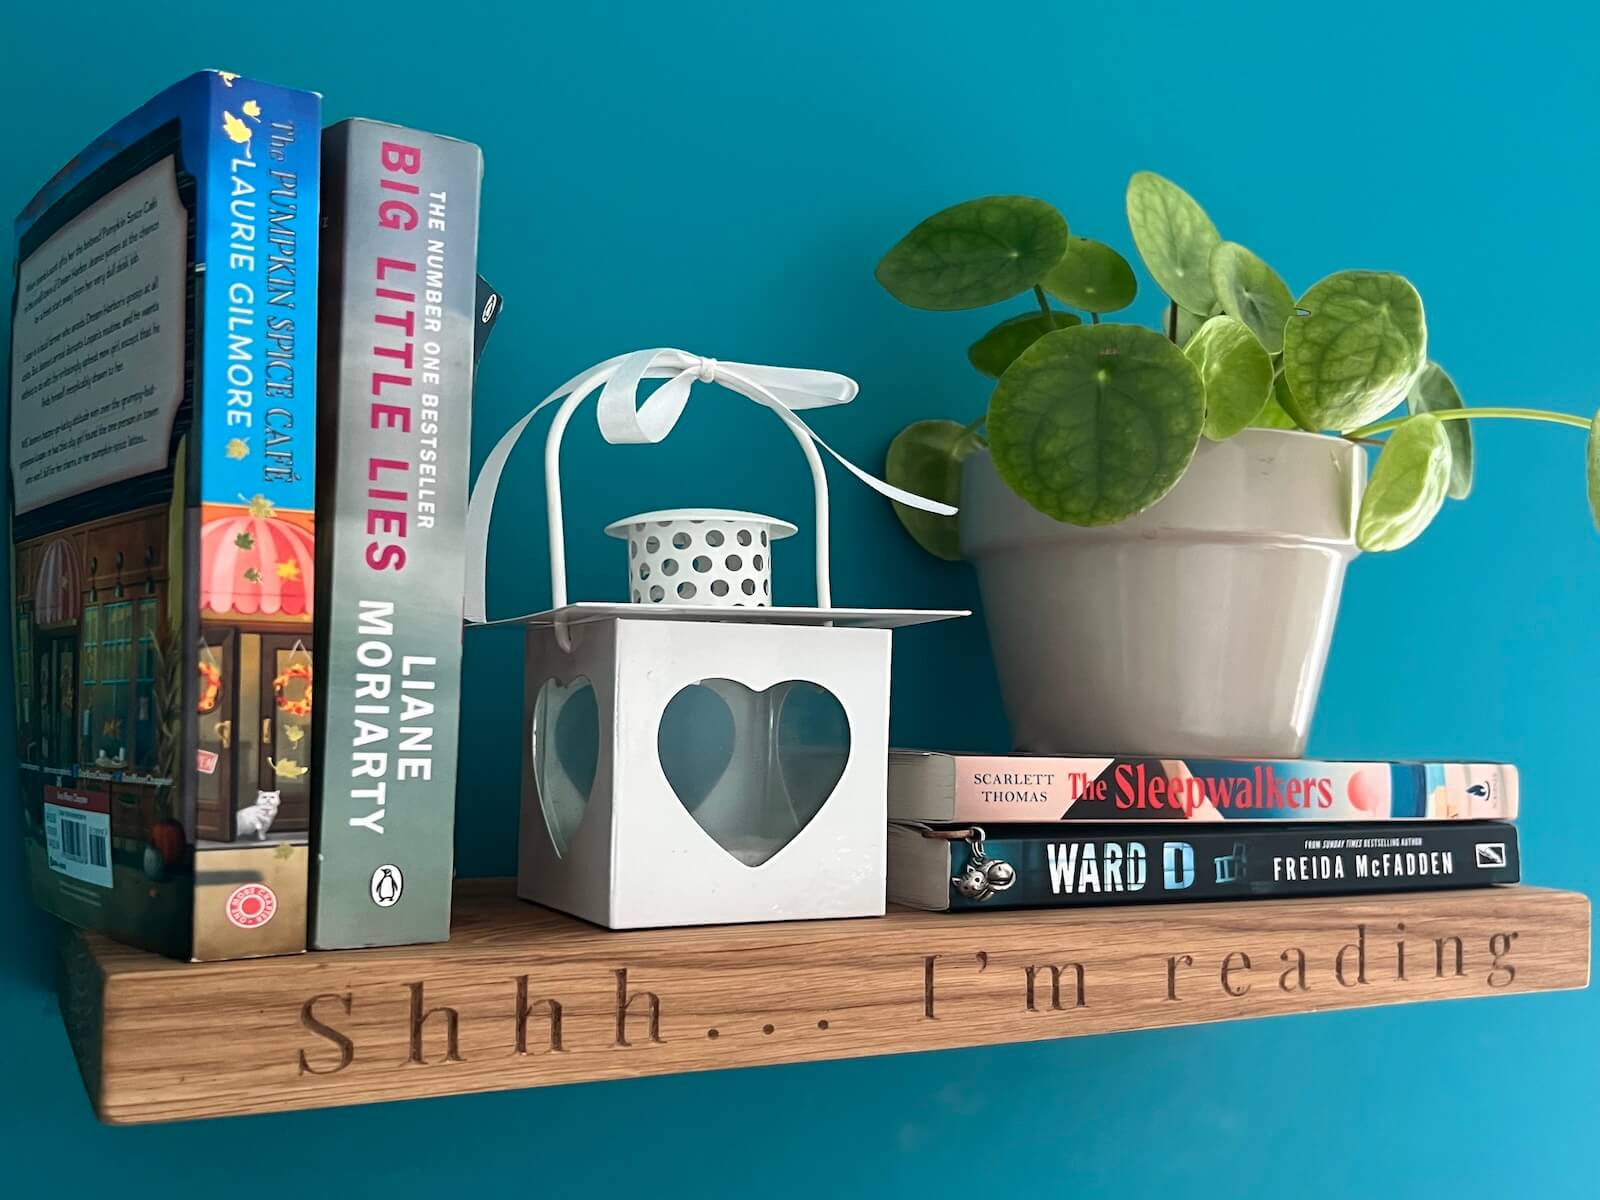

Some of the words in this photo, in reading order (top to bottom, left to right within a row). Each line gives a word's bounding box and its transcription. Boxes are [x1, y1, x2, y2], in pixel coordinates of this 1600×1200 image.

[269, 119, 295, 163] The
[229, 158, 256, 272] LAURIE
[377, 141, 421, 232] BIG
[427, 192, 447, 232] THE
[267, 167, 298, 310] PUMPKIN
[424, 240, 445, 333] NUMBER
[226, 283, 255, 428] GILMORE
[264, 313, 297, 399] SPICE
[370, 256, 417, 434] LITTLE
[422, 342, 441, 385] ONE
[264, 407, 302, 484] CAFÉ
[417, 394, 439, 529] BESTSELLER
[365, 457, 410, 571] LIES
[349, 600, 395, 834] MORIARTY
[397, 655, 437, 781] LIANE
[973, 773, 1055, 785] SCARLETT
[981, 791, 1048, 803] THOMAS
[1068, 772, 1107, 801] The
[1114, 763, 1333, 819] Sleepwalkers
[1047, 841, 1147, 894] WARD
[1162, 841, 1195, 890] D
[1273, 853, 1345, 882] FREIDA
[1356, 851, 1453, 879] McFADDEN
[1161, 922, 1520, 1001] reading
